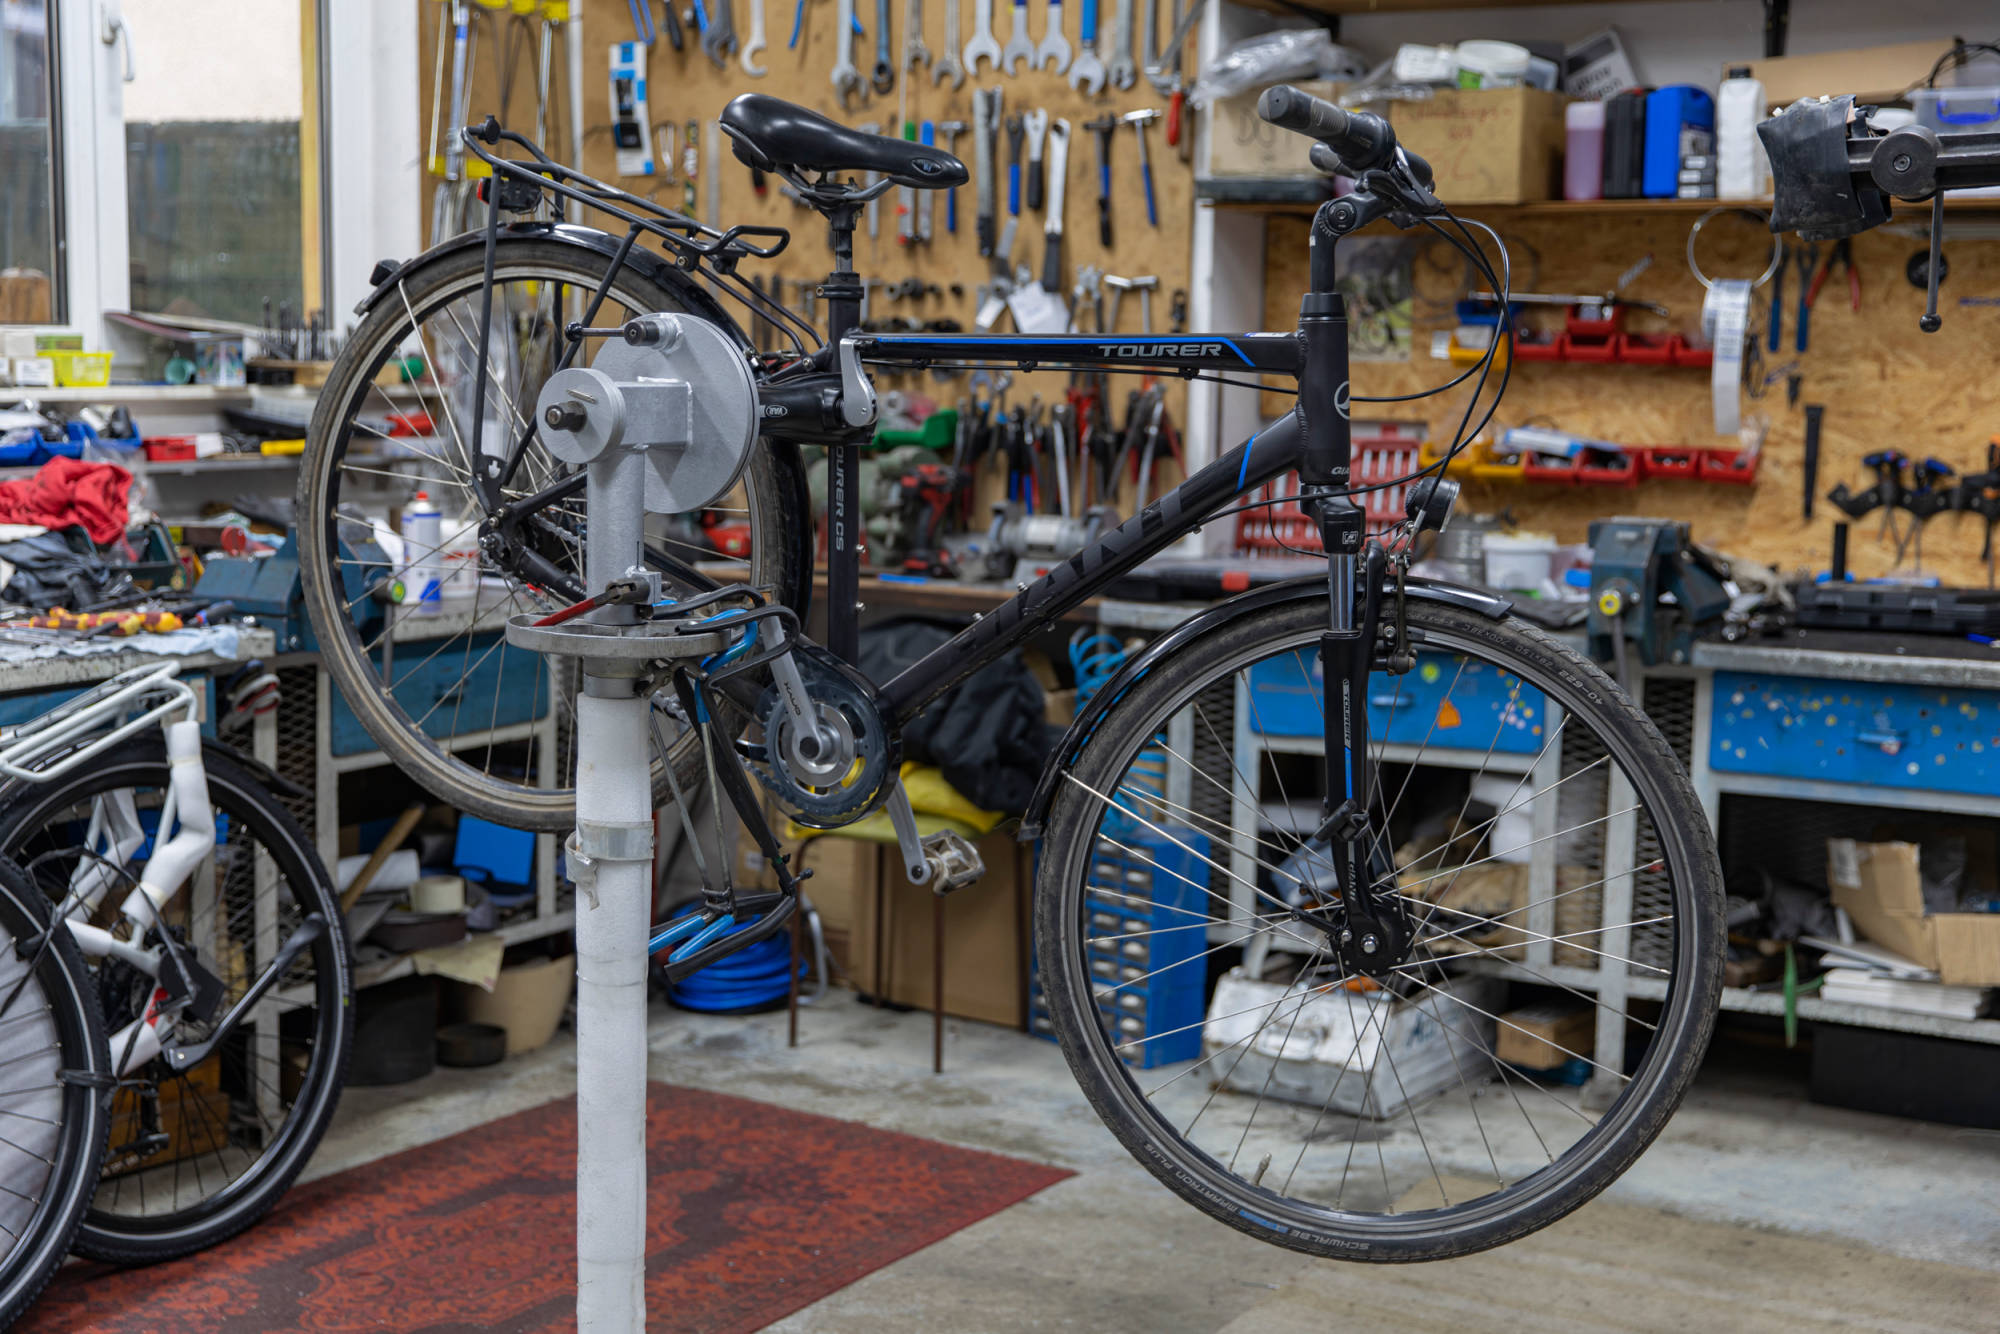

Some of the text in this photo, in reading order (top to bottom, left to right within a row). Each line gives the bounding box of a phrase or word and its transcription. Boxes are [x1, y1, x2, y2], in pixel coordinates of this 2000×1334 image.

[1098, 343, 1223, 357] TOURER
[835, 521, 845, 553] CS
[1558, 669, 1604, 706] 40-622
[1144, 1143, 1173, 1170] PLUS
[1290, 1230, 1371, 1250] SCHWALBE
